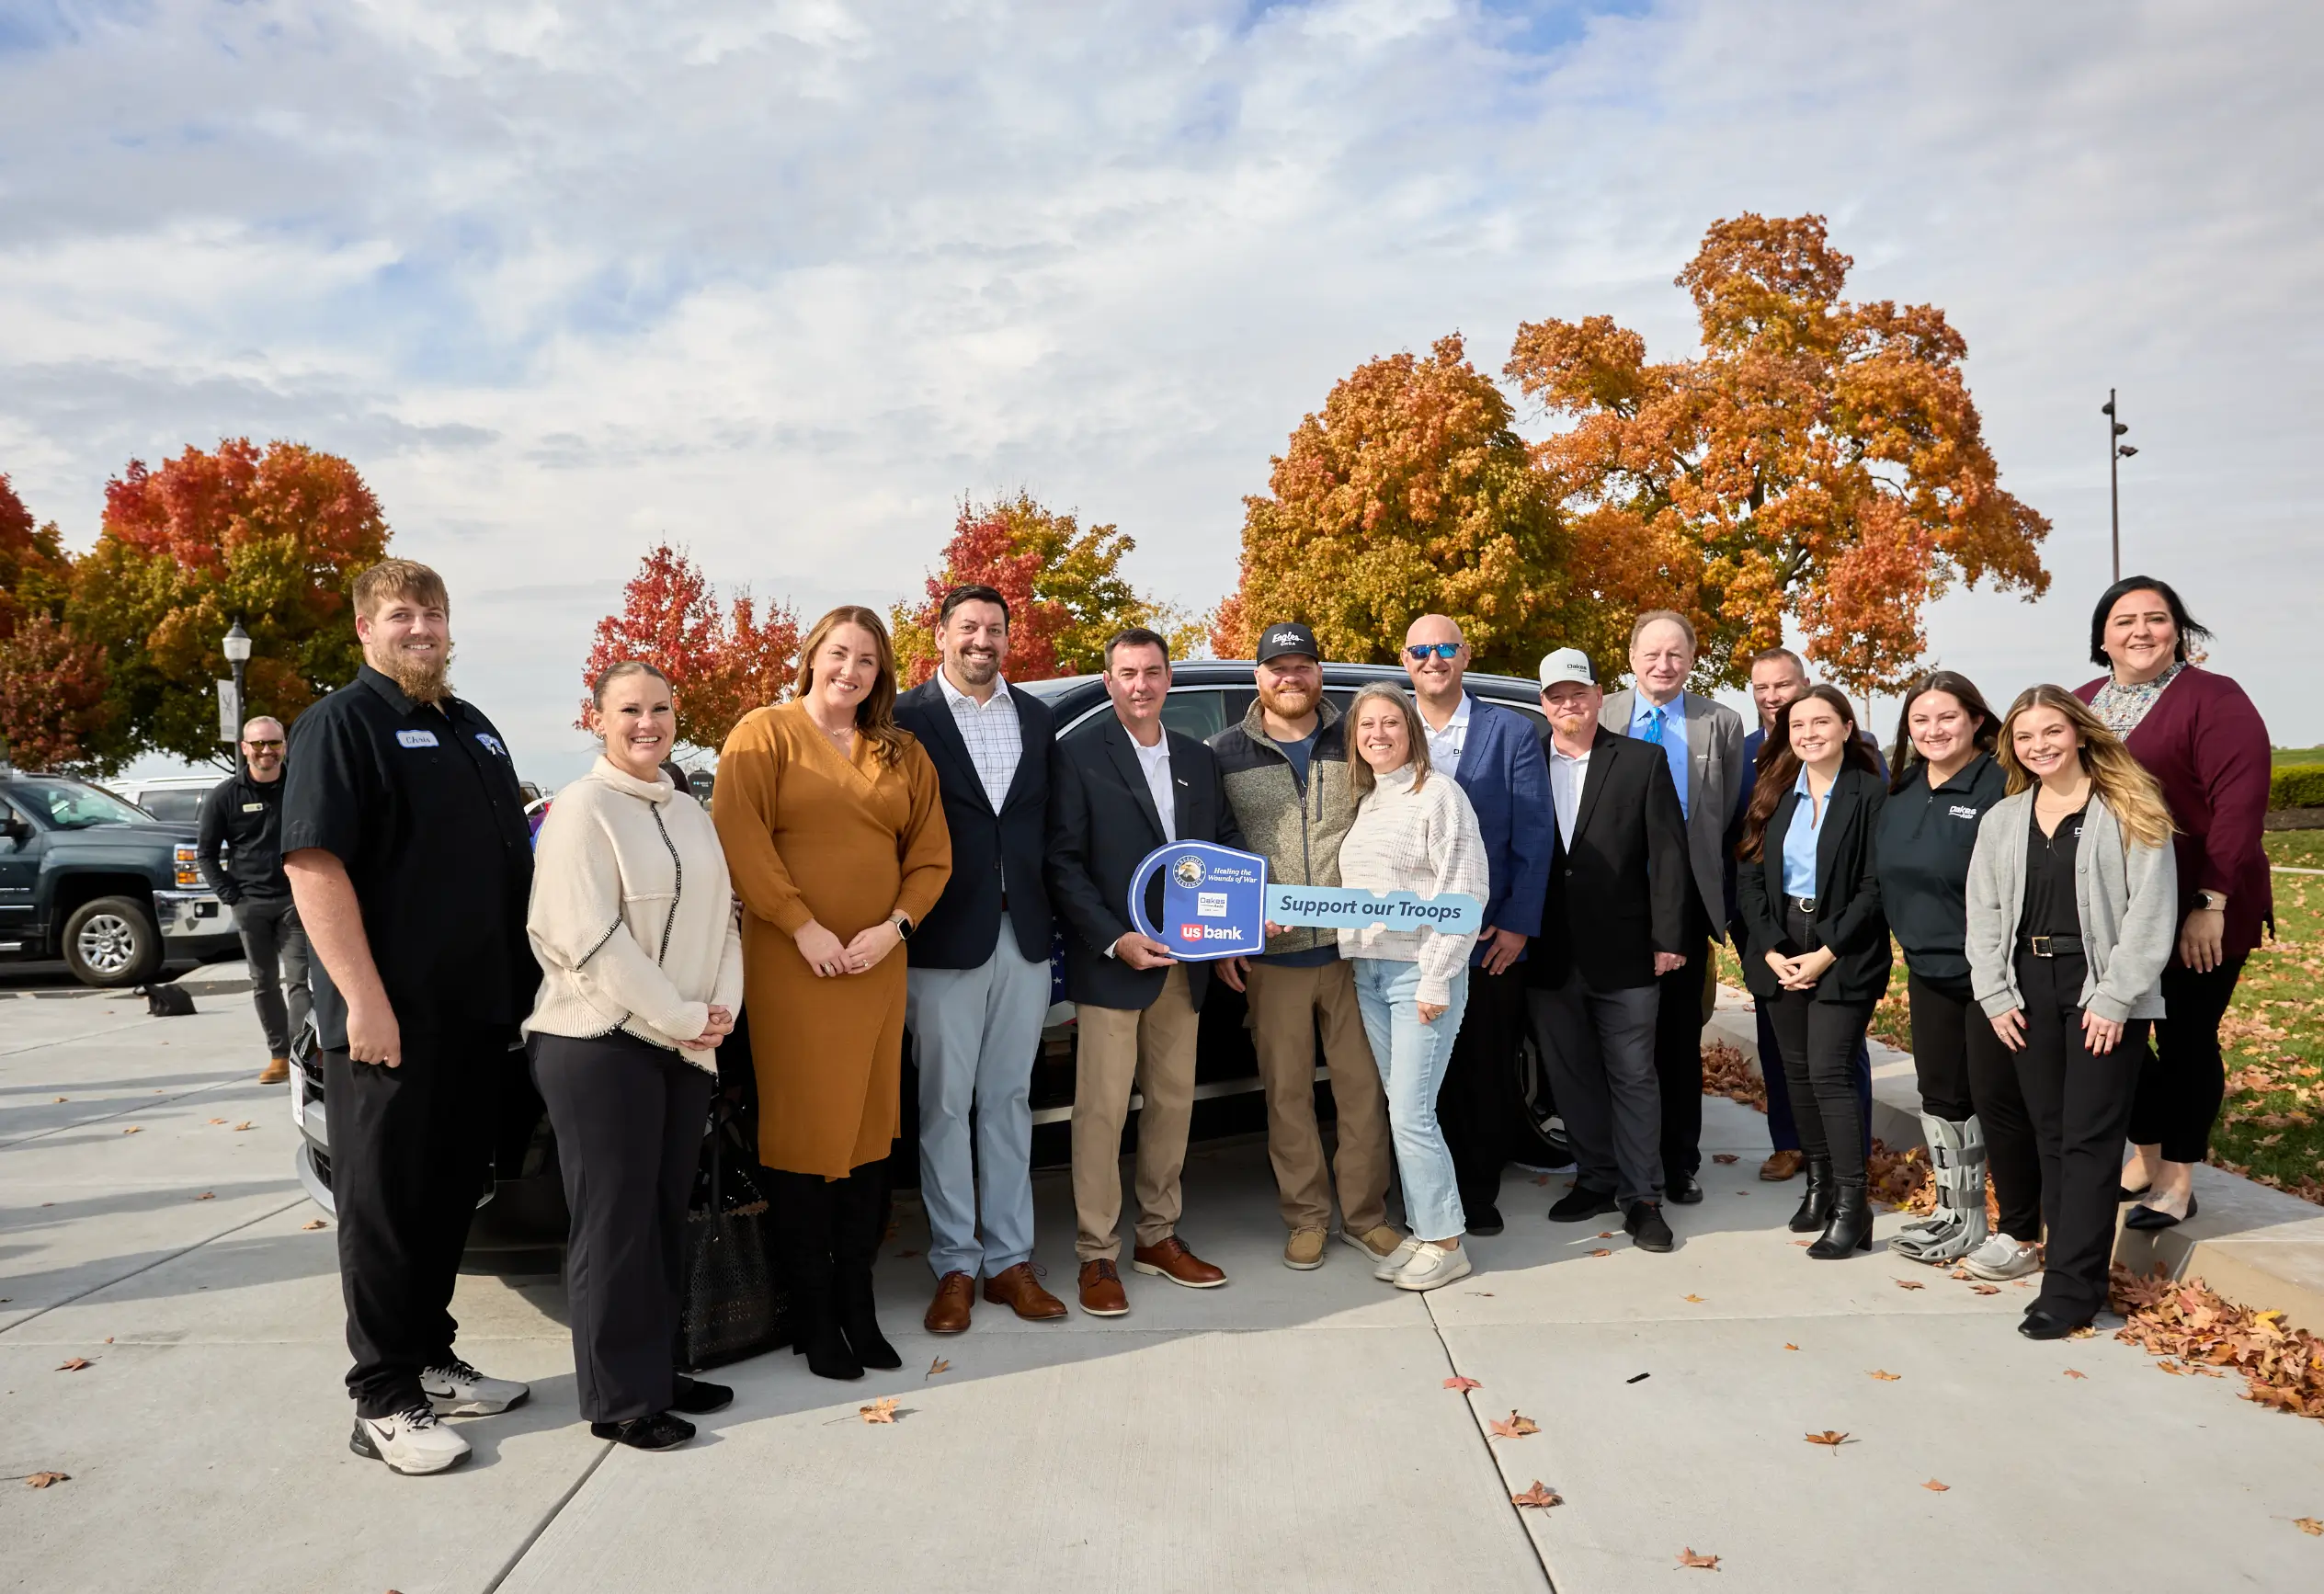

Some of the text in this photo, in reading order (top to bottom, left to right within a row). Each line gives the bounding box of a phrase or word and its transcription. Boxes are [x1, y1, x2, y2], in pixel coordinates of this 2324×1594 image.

[1272, 632, 1304, 643] Eagles
[1949, 805, 1977, 815] Oakes
[1213, 867, 1239, 876] Healing
[1208, 874, 1235, 882] Wounds
[1280, 894, 1462, 923] Support our Troops
[1183, 925, 1243, 940] us bank
